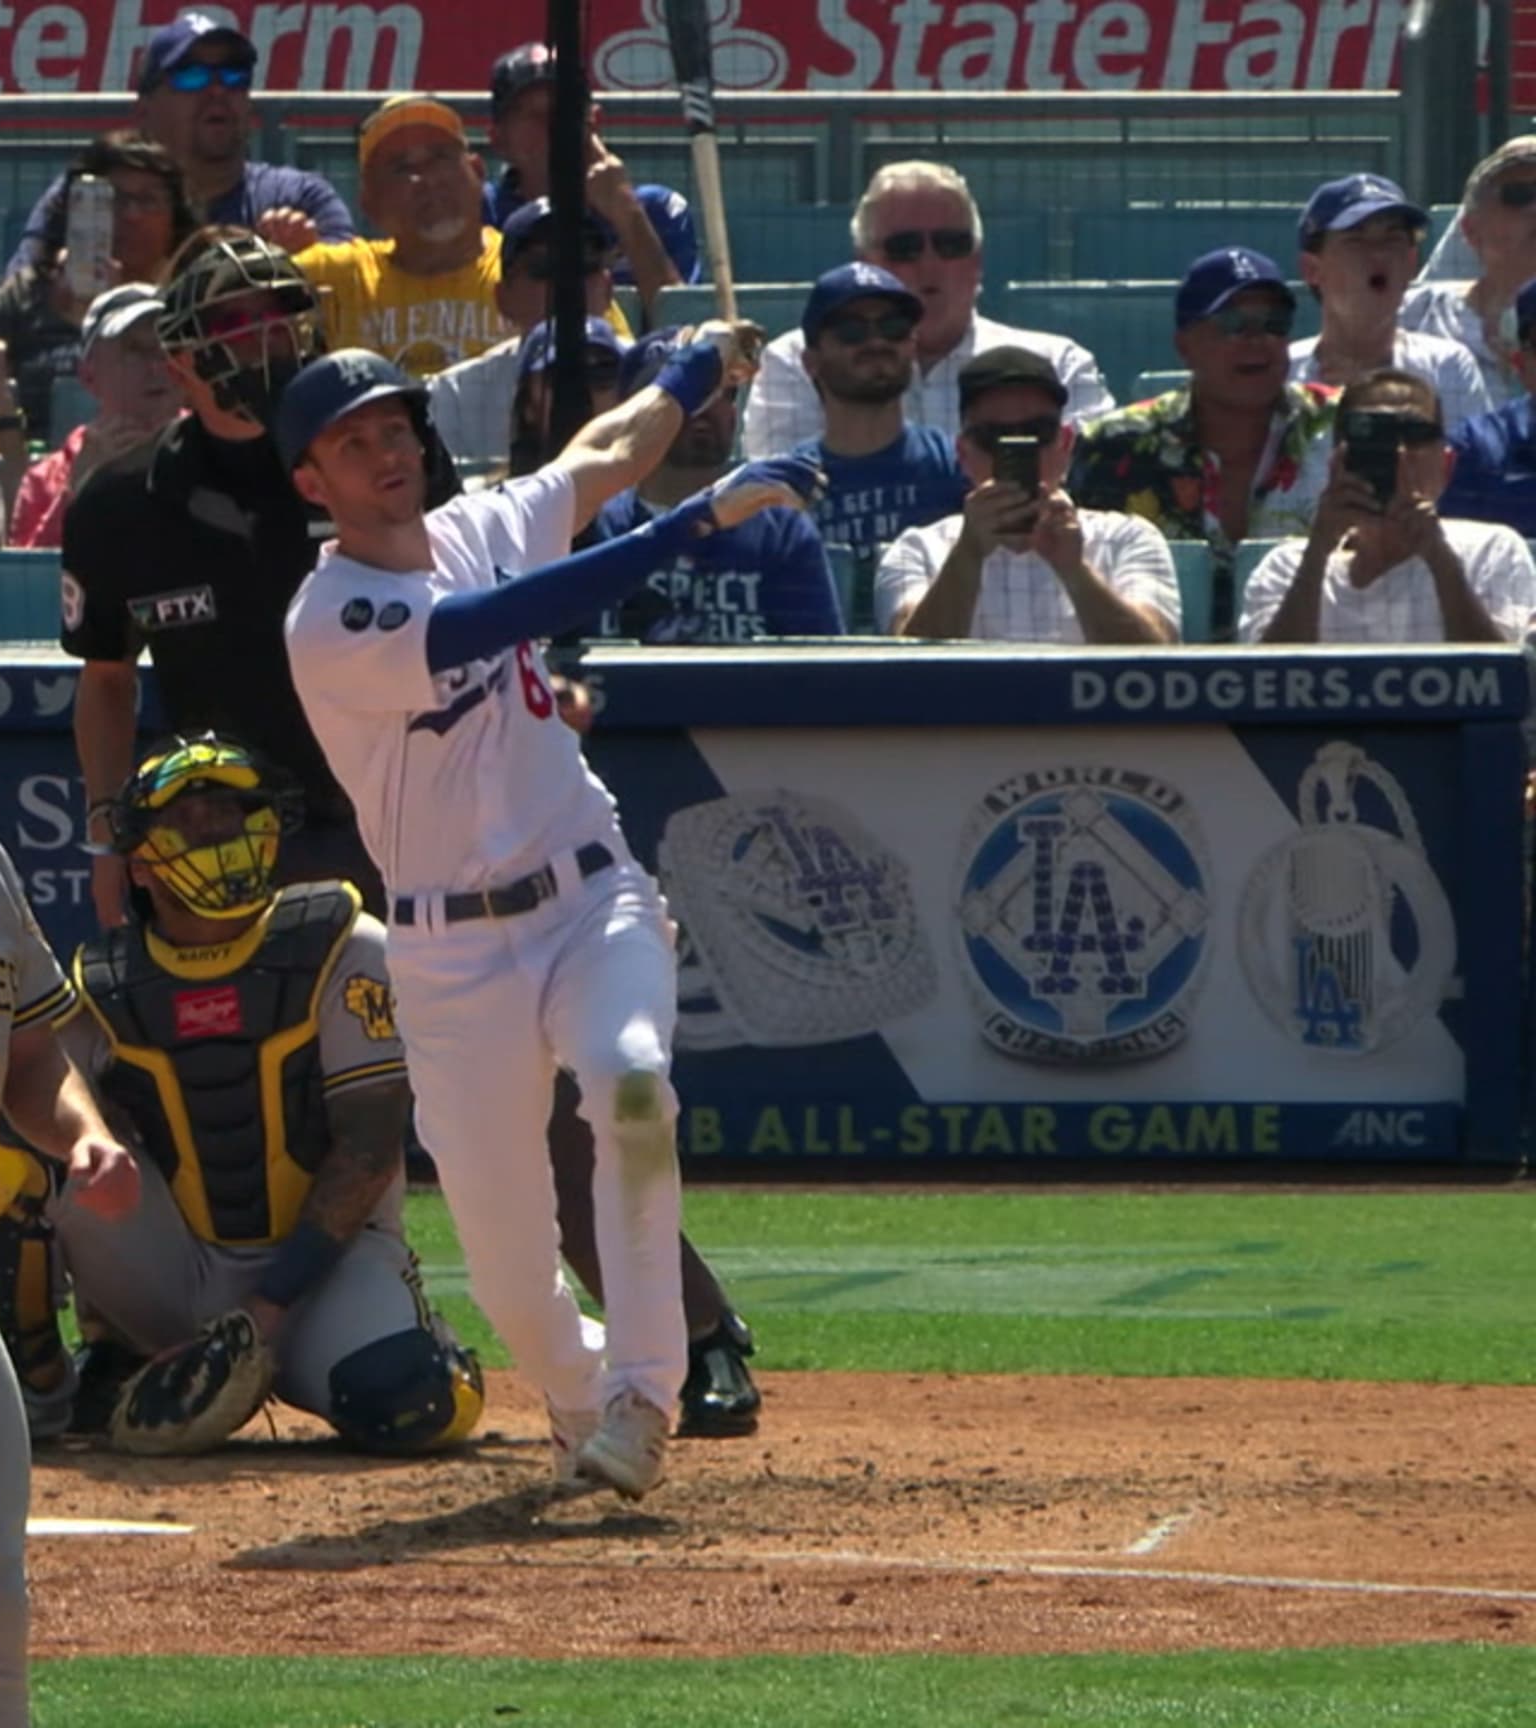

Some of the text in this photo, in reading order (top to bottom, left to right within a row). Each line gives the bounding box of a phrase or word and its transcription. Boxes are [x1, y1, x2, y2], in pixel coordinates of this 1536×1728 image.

[156, 592, 209, 623] FTX
[1072, 667, 1501, 710] DODGERS.COM
[15, 773, 88, 850] S
[1019, 817, 1148, 995] LA
[749, 1105, 1058, 1154] ALL-STAR
[1087, 1104, 1281, 1153] GAME
